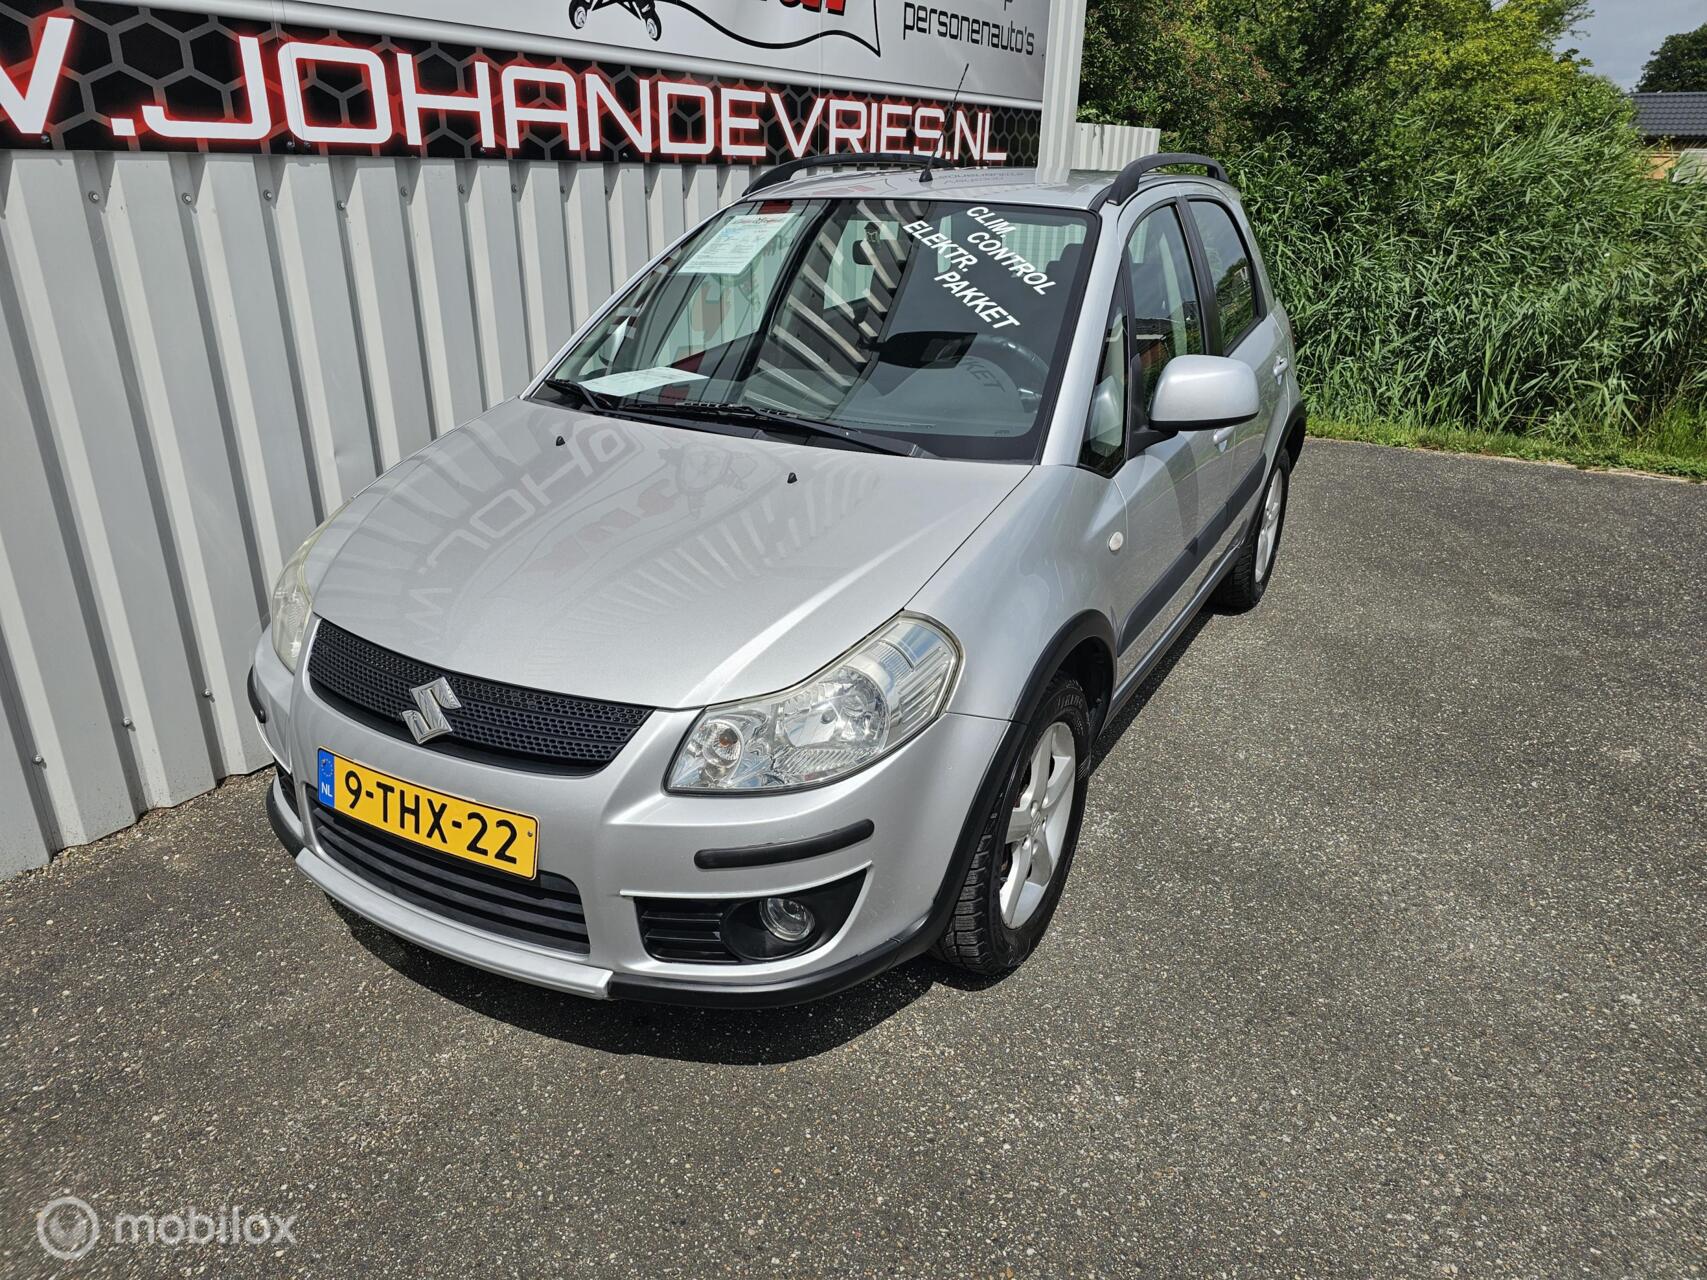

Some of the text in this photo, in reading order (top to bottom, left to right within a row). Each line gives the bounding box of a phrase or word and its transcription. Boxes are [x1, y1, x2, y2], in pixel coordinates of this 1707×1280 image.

[903, 2, 1035, 55] personenauto's
[902, 220, 979, 272] ELEKTR.
[966, 206, 1017, 238] CLIM.
[966, 231, 1057, 296] CONTROL
[934, 271, 1021, 329] PAKKET
[321, 781, 333, 799] NL
[344, 770, 518, 865] 9-THX-22
